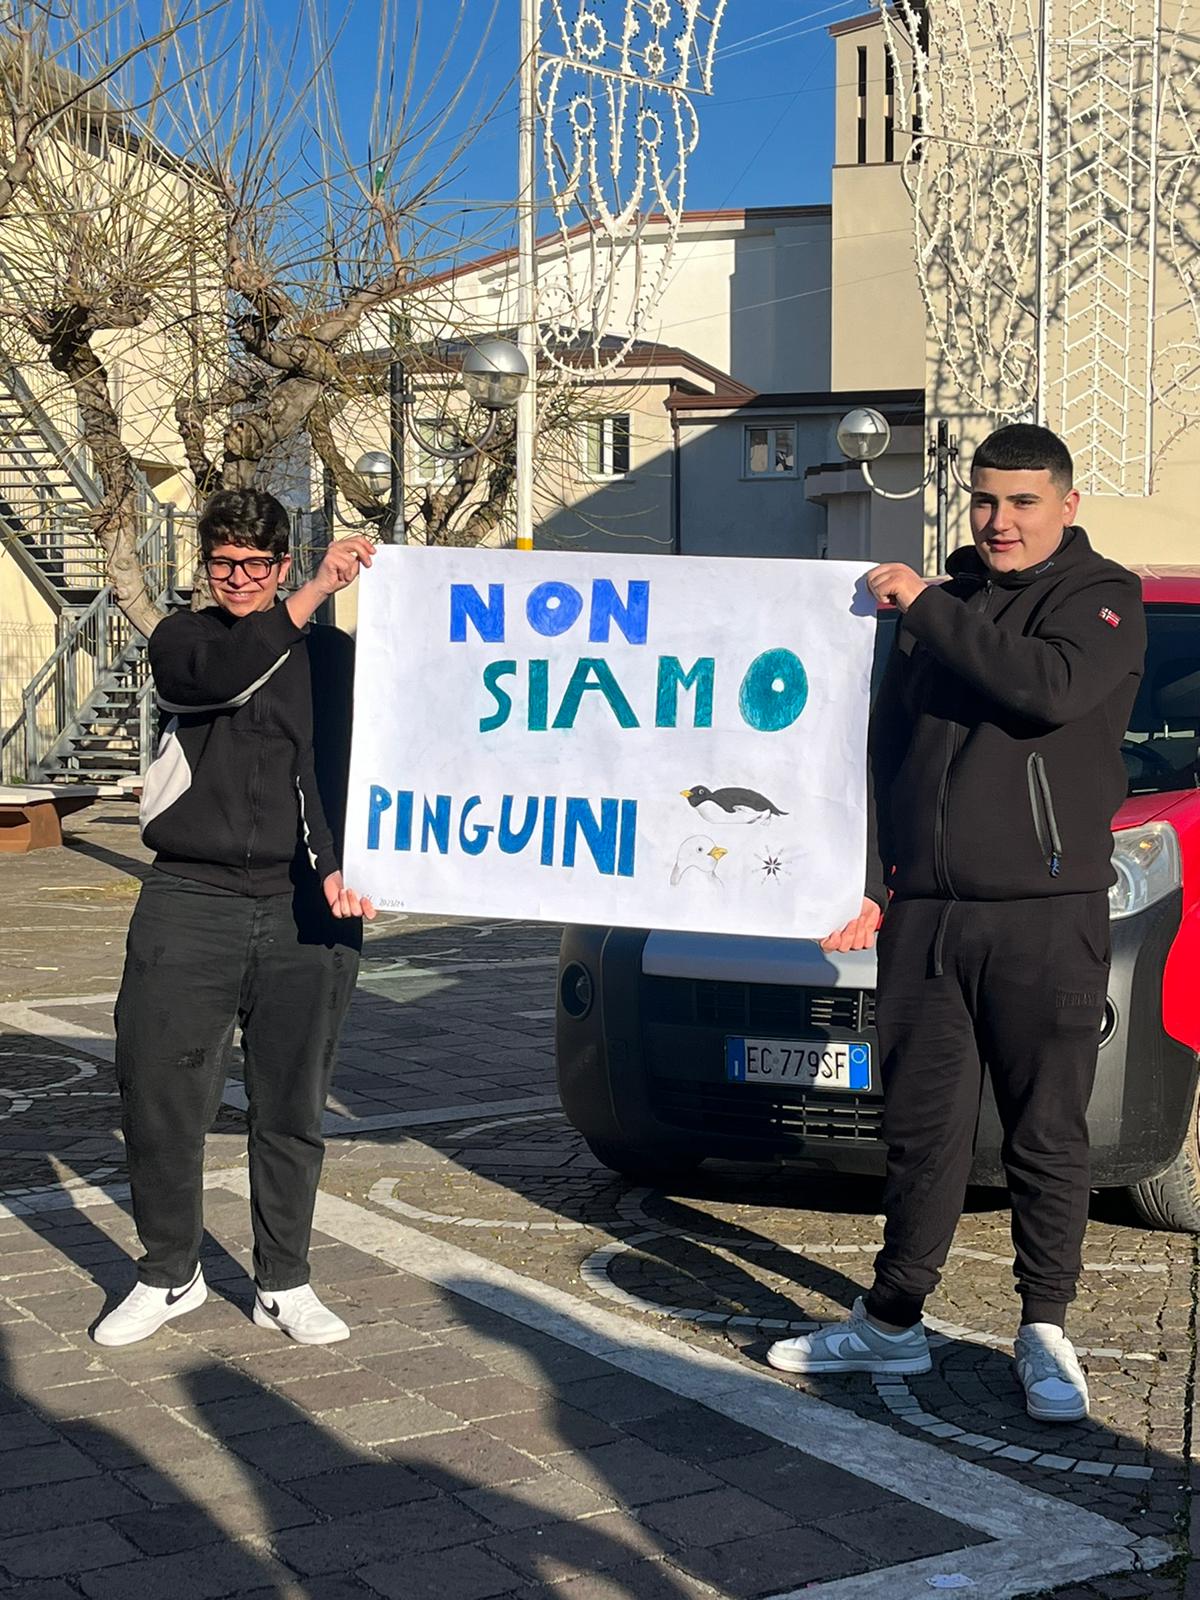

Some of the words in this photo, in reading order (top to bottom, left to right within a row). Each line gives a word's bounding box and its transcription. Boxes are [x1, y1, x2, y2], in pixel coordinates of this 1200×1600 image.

[449, 578, 650, 645] NON
[479, 648, 809, 733] SIAMO
[367, 785, 638, 878] PINGUINI
